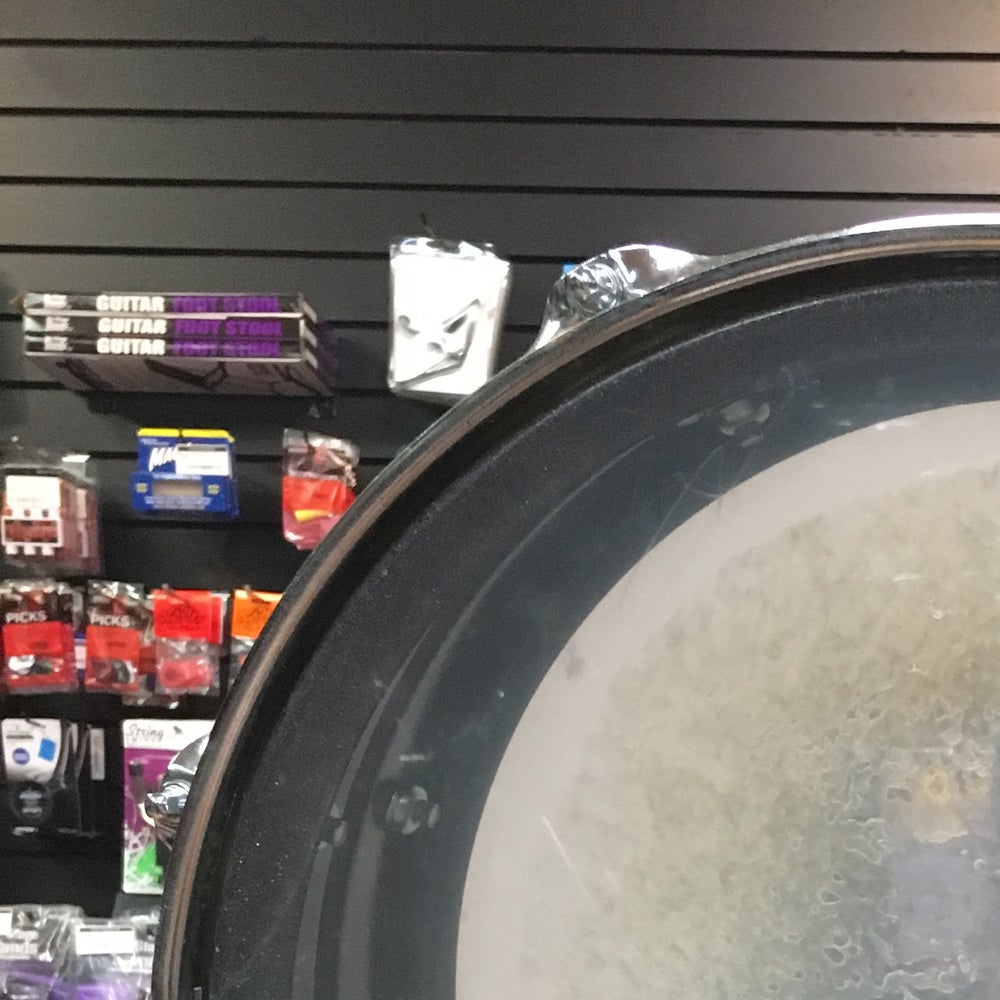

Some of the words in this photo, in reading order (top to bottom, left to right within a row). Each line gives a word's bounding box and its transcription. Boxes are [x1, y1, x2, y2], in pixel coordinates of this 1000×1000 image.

[96, 294, 165, 311] GUITAR
[98, 317, 167, 334] GUITAR
[96, 337, 165, 354] GUITAR
[5, 609, 48, 623] PICKS
[89, 611, 131, 627] PICKS
